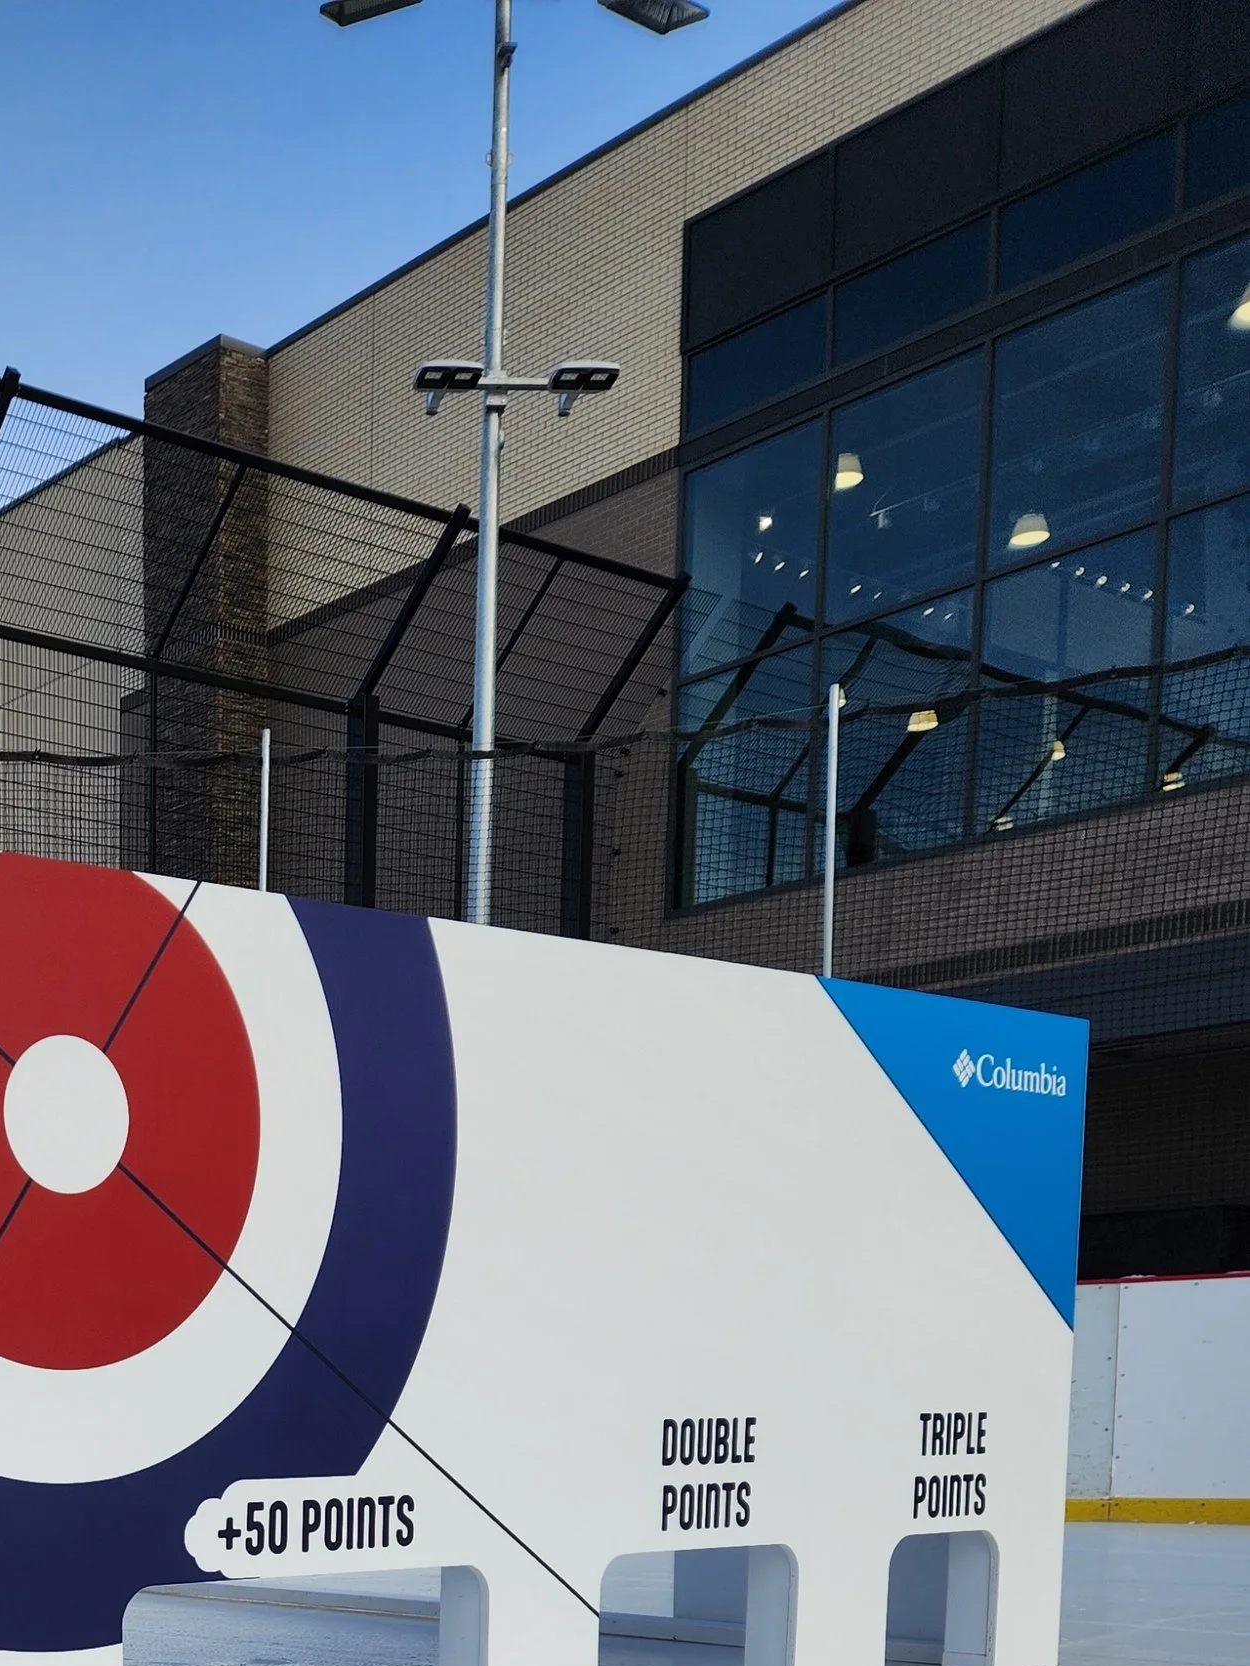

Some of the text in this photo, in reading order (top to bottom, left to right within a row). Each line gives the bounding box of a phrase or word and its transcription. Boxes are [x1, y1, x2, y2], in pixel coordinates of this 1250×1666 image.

[976, 1053, 1067, 1097] Columbia
[661, 1417, 757, 1467] DOUBLE
[919, 1411, 988, 1457] TRIPLE
[661, 1481, 752, 1532] POINTS
[912, 1473, 987, 1520] POINTS
[216, 1494, 416, 1556] +50 POINTS
